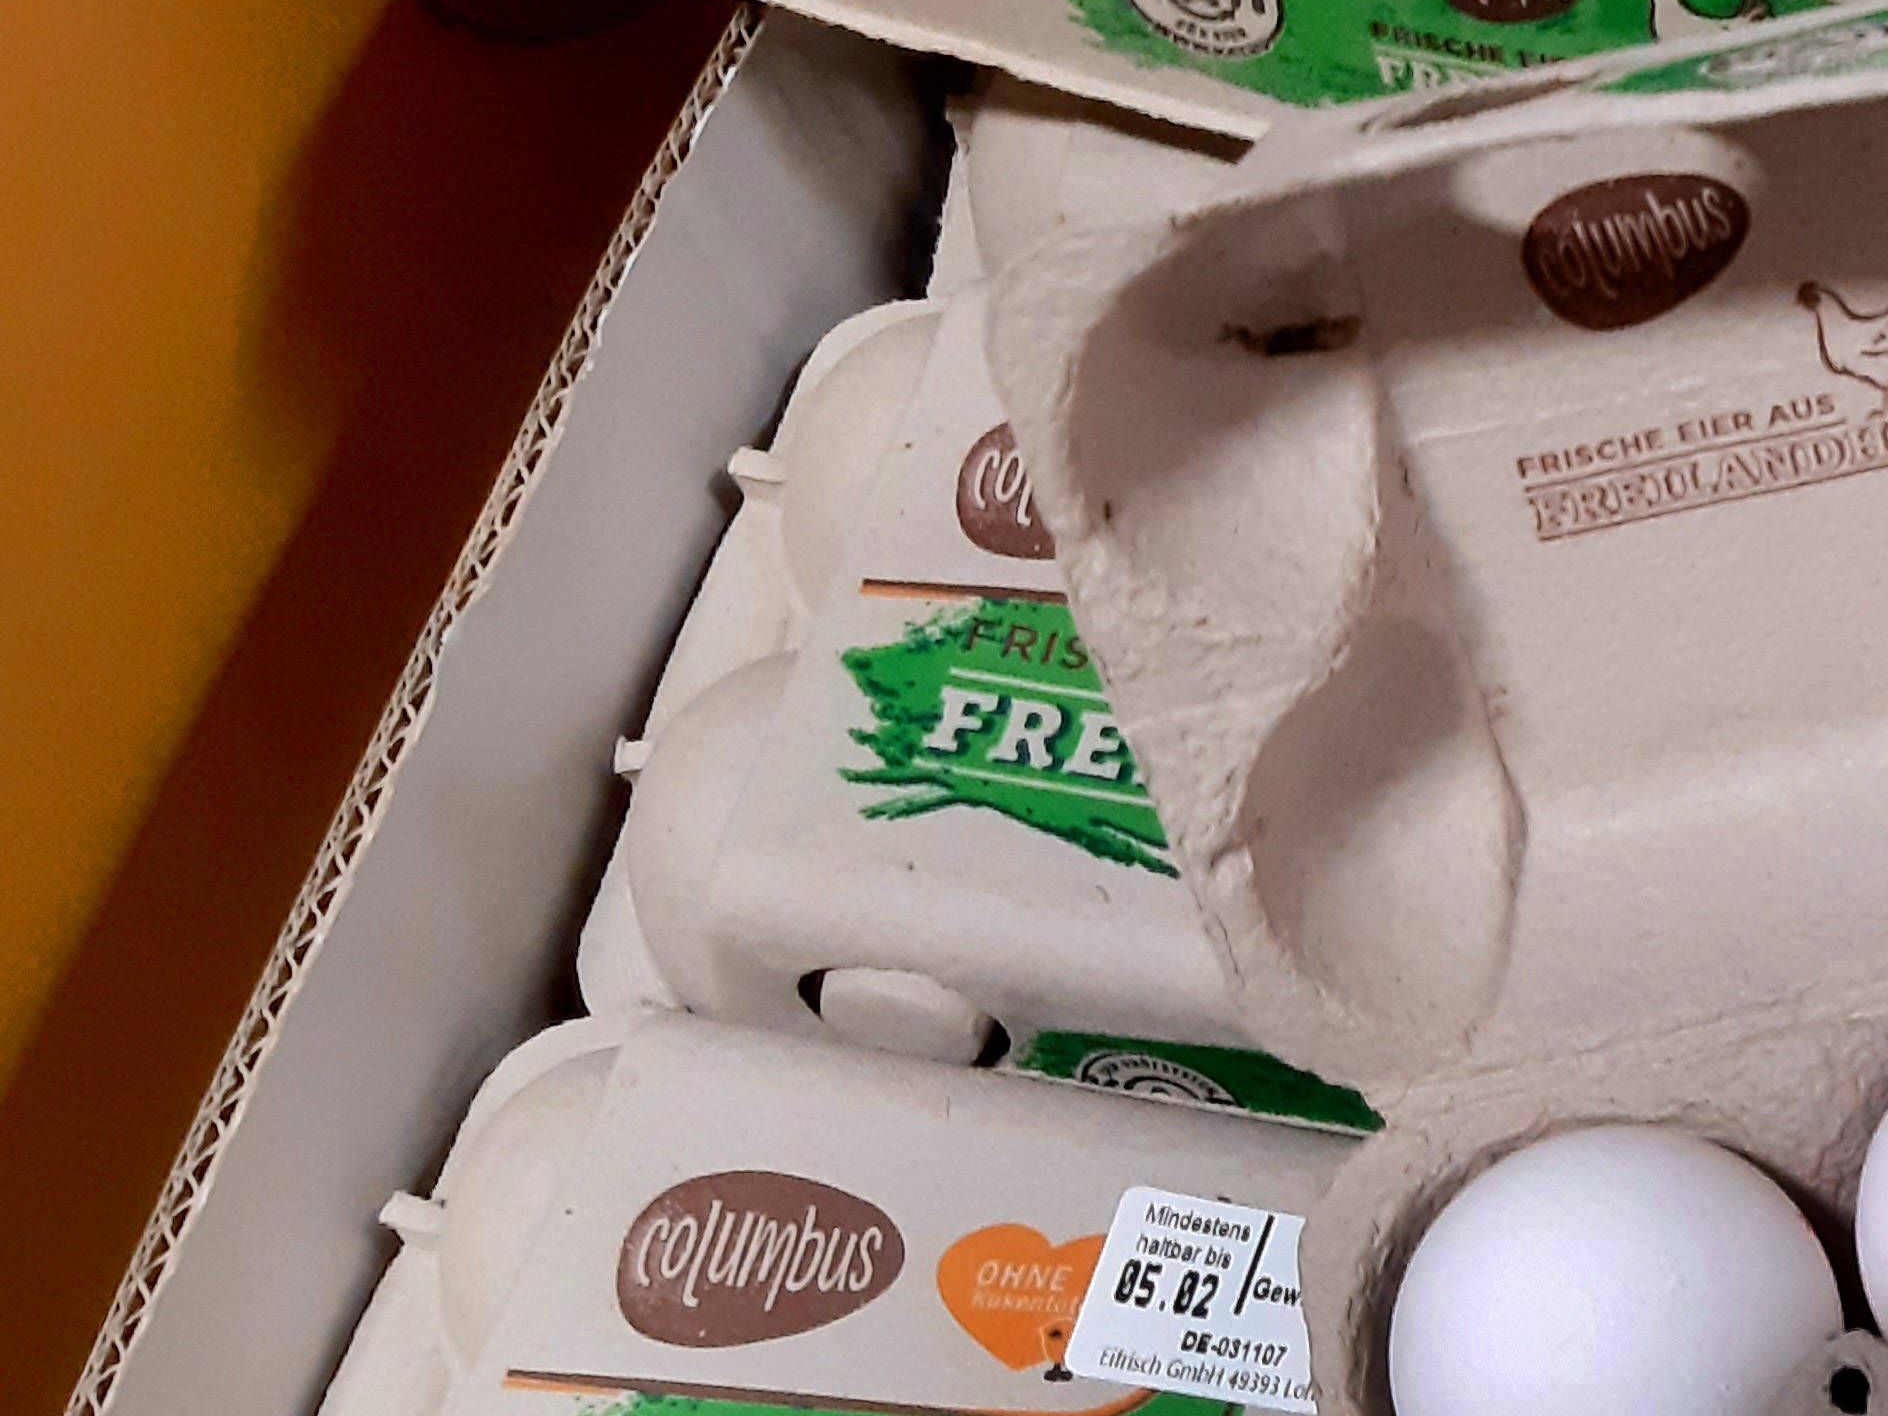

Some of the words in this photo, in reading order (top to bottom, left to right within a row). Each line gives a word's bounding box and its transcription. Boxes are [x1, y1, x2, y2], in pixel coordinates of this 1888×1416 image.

[1541, 185, 1736, 301] columbus
[1514, 425, 1668, 480] FRISCHE
[1675, 411, 1756, 448] EIER
[1766, 392, 1837, 428] AUS
[924, 684, 1127, 780] FRE
[1145, 1202, 1253, 1244] Mindestens
[633, 1198, 884, 1310] columbus
[977, 1258, 1074, 1292] OHNE
[1135, 1233, 1203, 1262] haltbar
[1205, 1246, 1234, 1271] bis
[1112, 1258, 1221, 1319] 05.02
[1098, 1345, 1161, 1377] Eifrisch
[1165, 1358, 1226, 1386] GmbH
[1229, 1368, 1283, 1397] 49393
[1180, 1328, 1289, 1369] DE-031107
